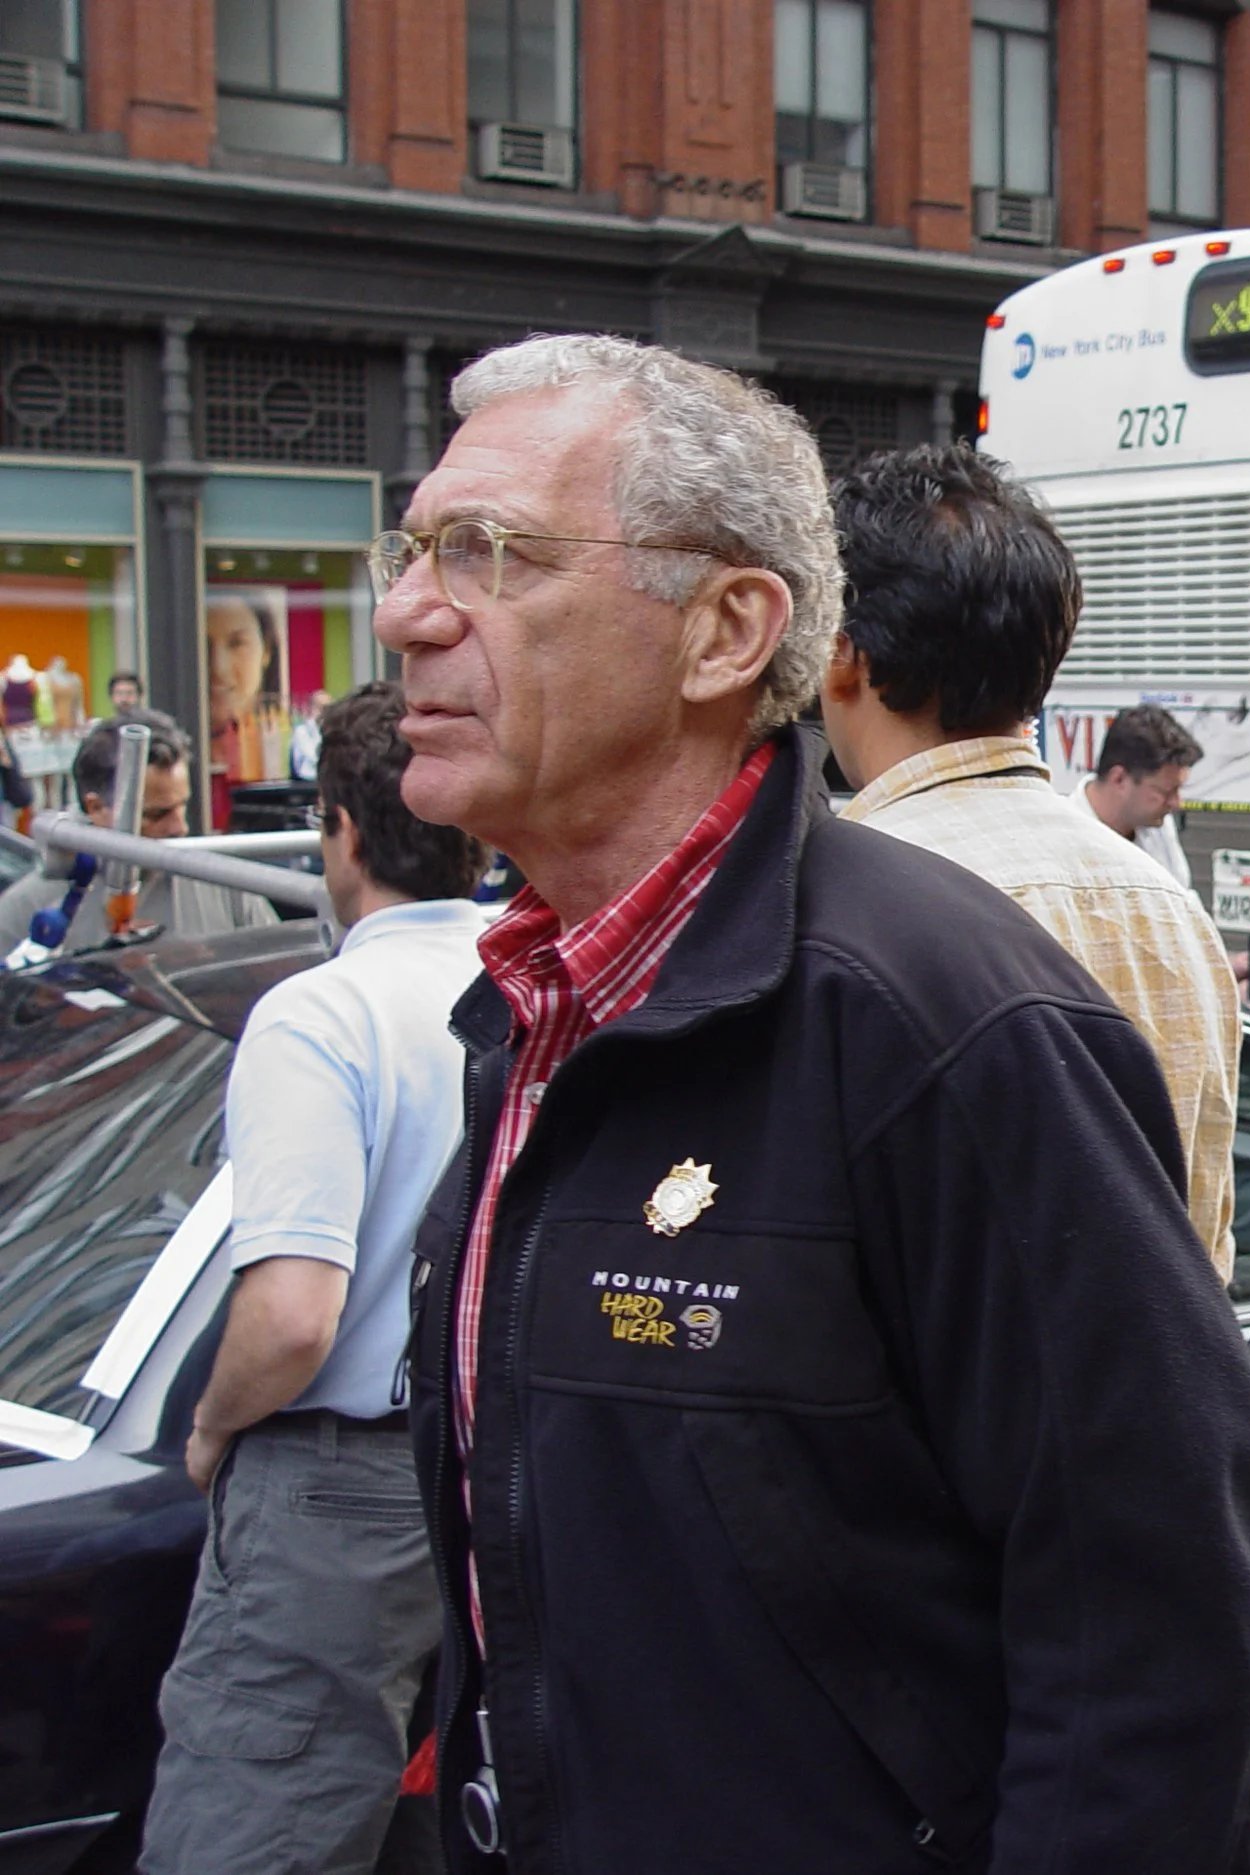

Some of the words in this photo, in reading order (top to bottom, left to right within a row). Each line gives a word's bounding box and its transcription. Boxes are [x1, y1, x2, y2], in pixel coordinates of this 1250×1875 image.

[1041, 344, 1067, 359] New
[1073, 338, 1100, 355] York
[1104, 333, 1134, 355] City
[1138, 329, 1166, 347] Bus
[1117, 402, 1188, 450] 2737
[592, 1271, 740, 1300] MOUNTAIN
[601, 1292, 665, 1319] HARD
[612, 1316, 677, 1348] WEAR
